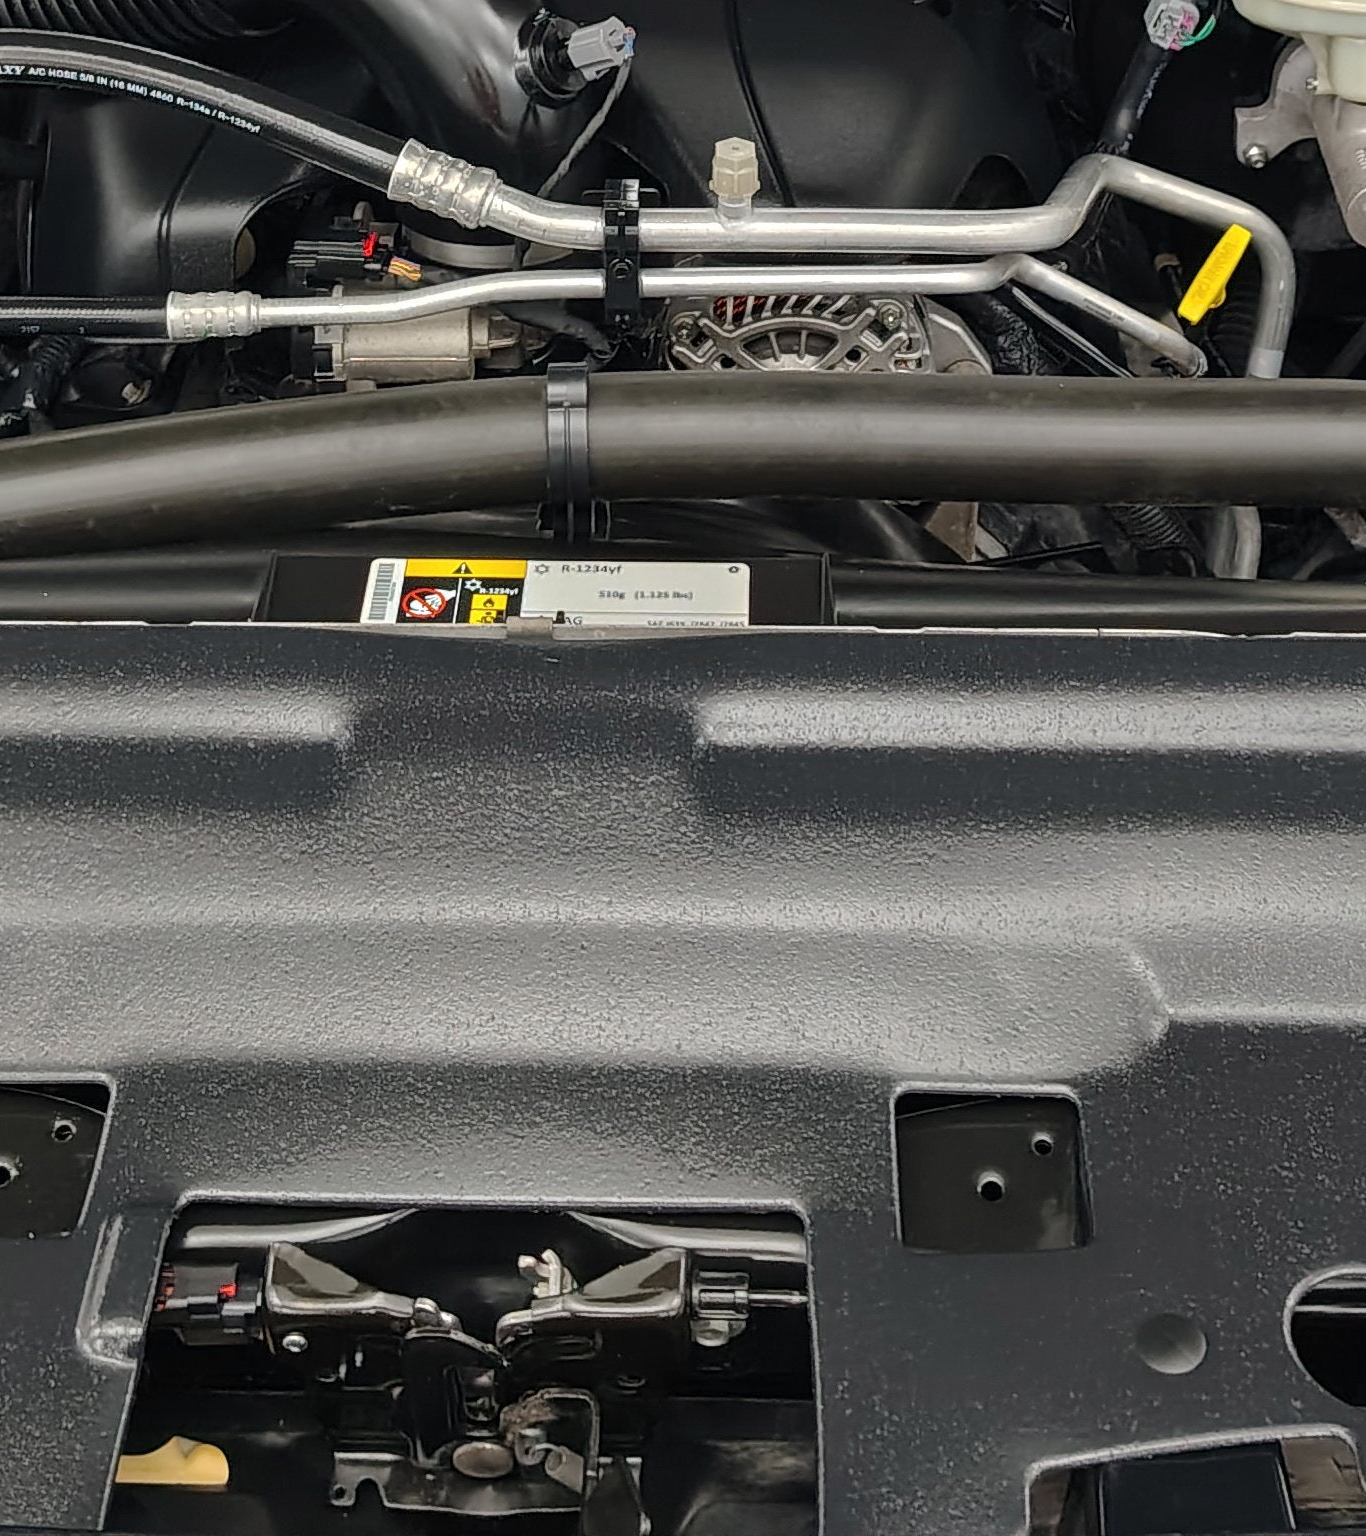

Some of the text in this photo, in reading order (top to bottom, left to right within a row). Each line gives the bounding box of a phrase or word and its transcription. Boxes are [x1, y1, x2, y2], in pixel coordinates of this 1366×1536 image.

[27, 67, 46, 76] A/C
[48, 68, 77, 80] HOSE
[97, 76, 108, 85] IN
[217, 111, 261, 134] R-1234yf
[561, 564, 623, 575] R-1234yf
[479, 587, 519, 596] R-1234yf
